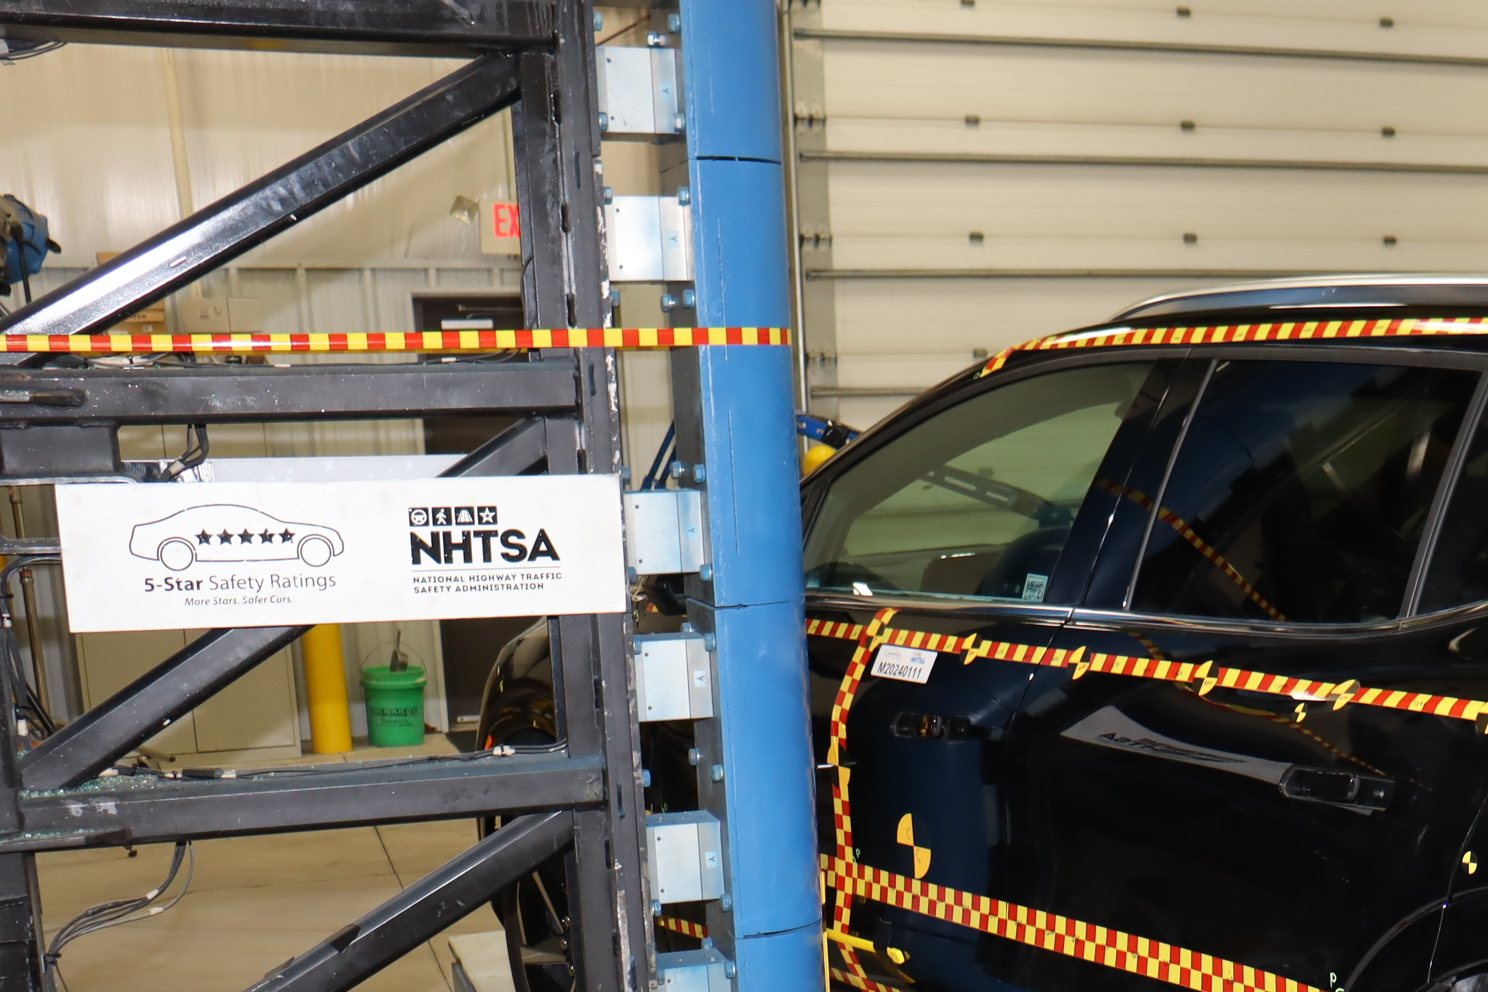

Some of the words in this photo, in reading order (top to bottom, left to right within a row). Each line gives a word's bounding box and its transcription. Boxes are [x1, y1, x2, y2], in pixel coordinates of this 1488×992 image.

[493, 203, 521, 238] EX
[410, 528, 561, 565] NHTSA
[144, 577, 203, 592] 5-Star
[209, 574, 264, 593] Safety
[270, 573, 336, 591] Ratings
[413, 575, 465, 584] NATIONAL
[469, 573, 517, 582] HIGHWAY
[521, 572, 562, 581] TRAFFIC
[414, 585, 451, 594] SAFETY
[455, 582, 544, 593] ADMINISTRATION
[184, 597, 211, 607] More
[213, 596, 240, 606] Stars.
[242, 595, 267, 605] Safer
[878, 661, 922, 680] M20240111
